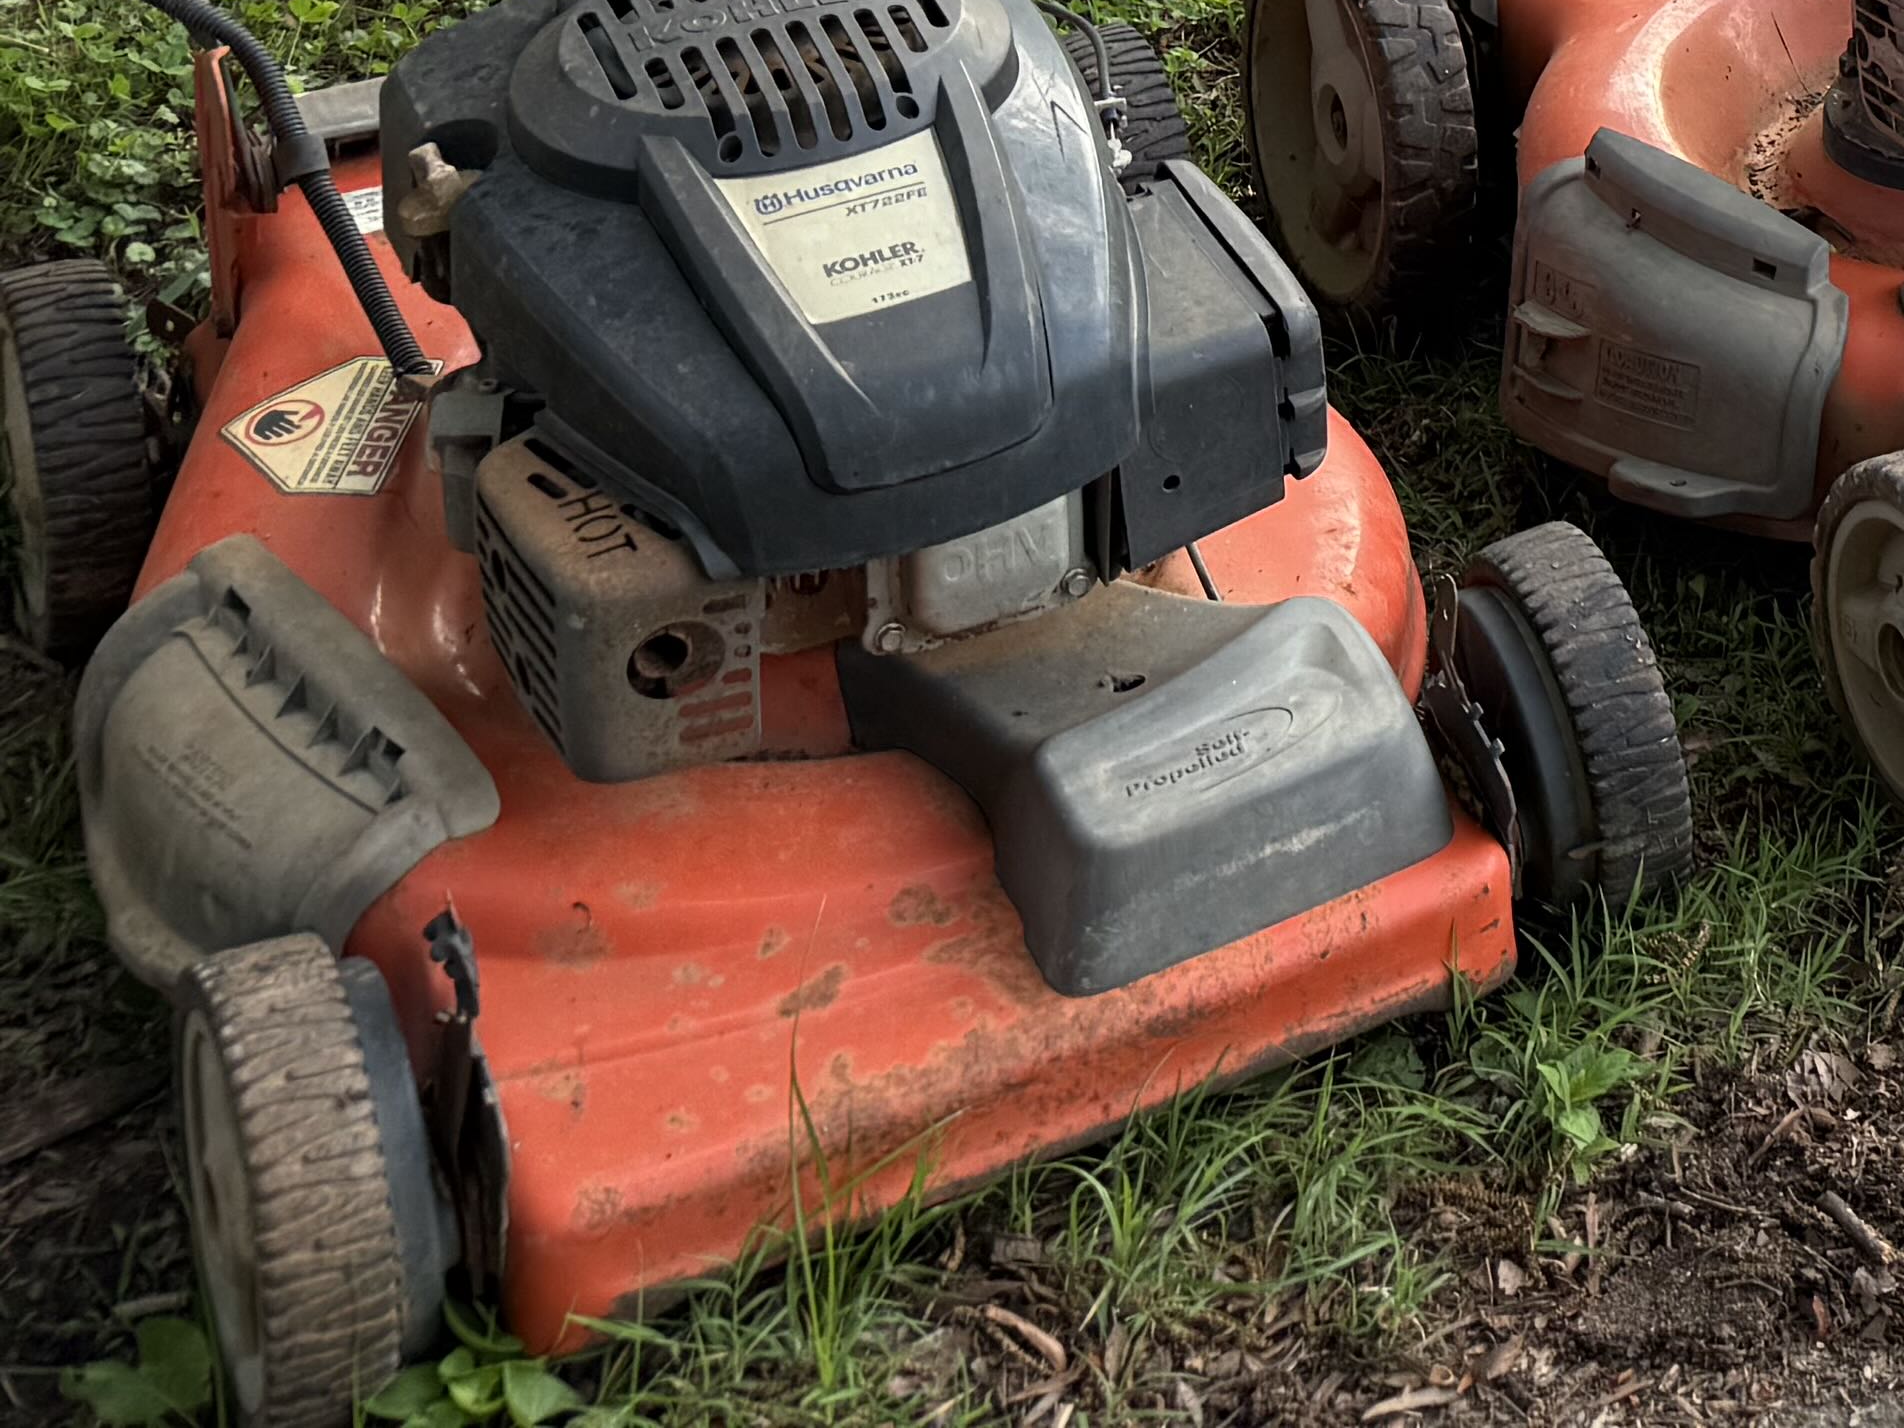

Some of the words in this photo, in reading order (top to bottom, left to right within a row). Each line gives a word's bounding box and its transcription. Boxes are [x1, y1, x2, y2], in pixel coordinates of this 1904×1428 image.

[784, 162, 918, 207] Husqvarna
[345, 387, 413, 477] ANGER
[557, 489, 638, 560] HOT
[1125, 745, 1245, 797] Propelled
